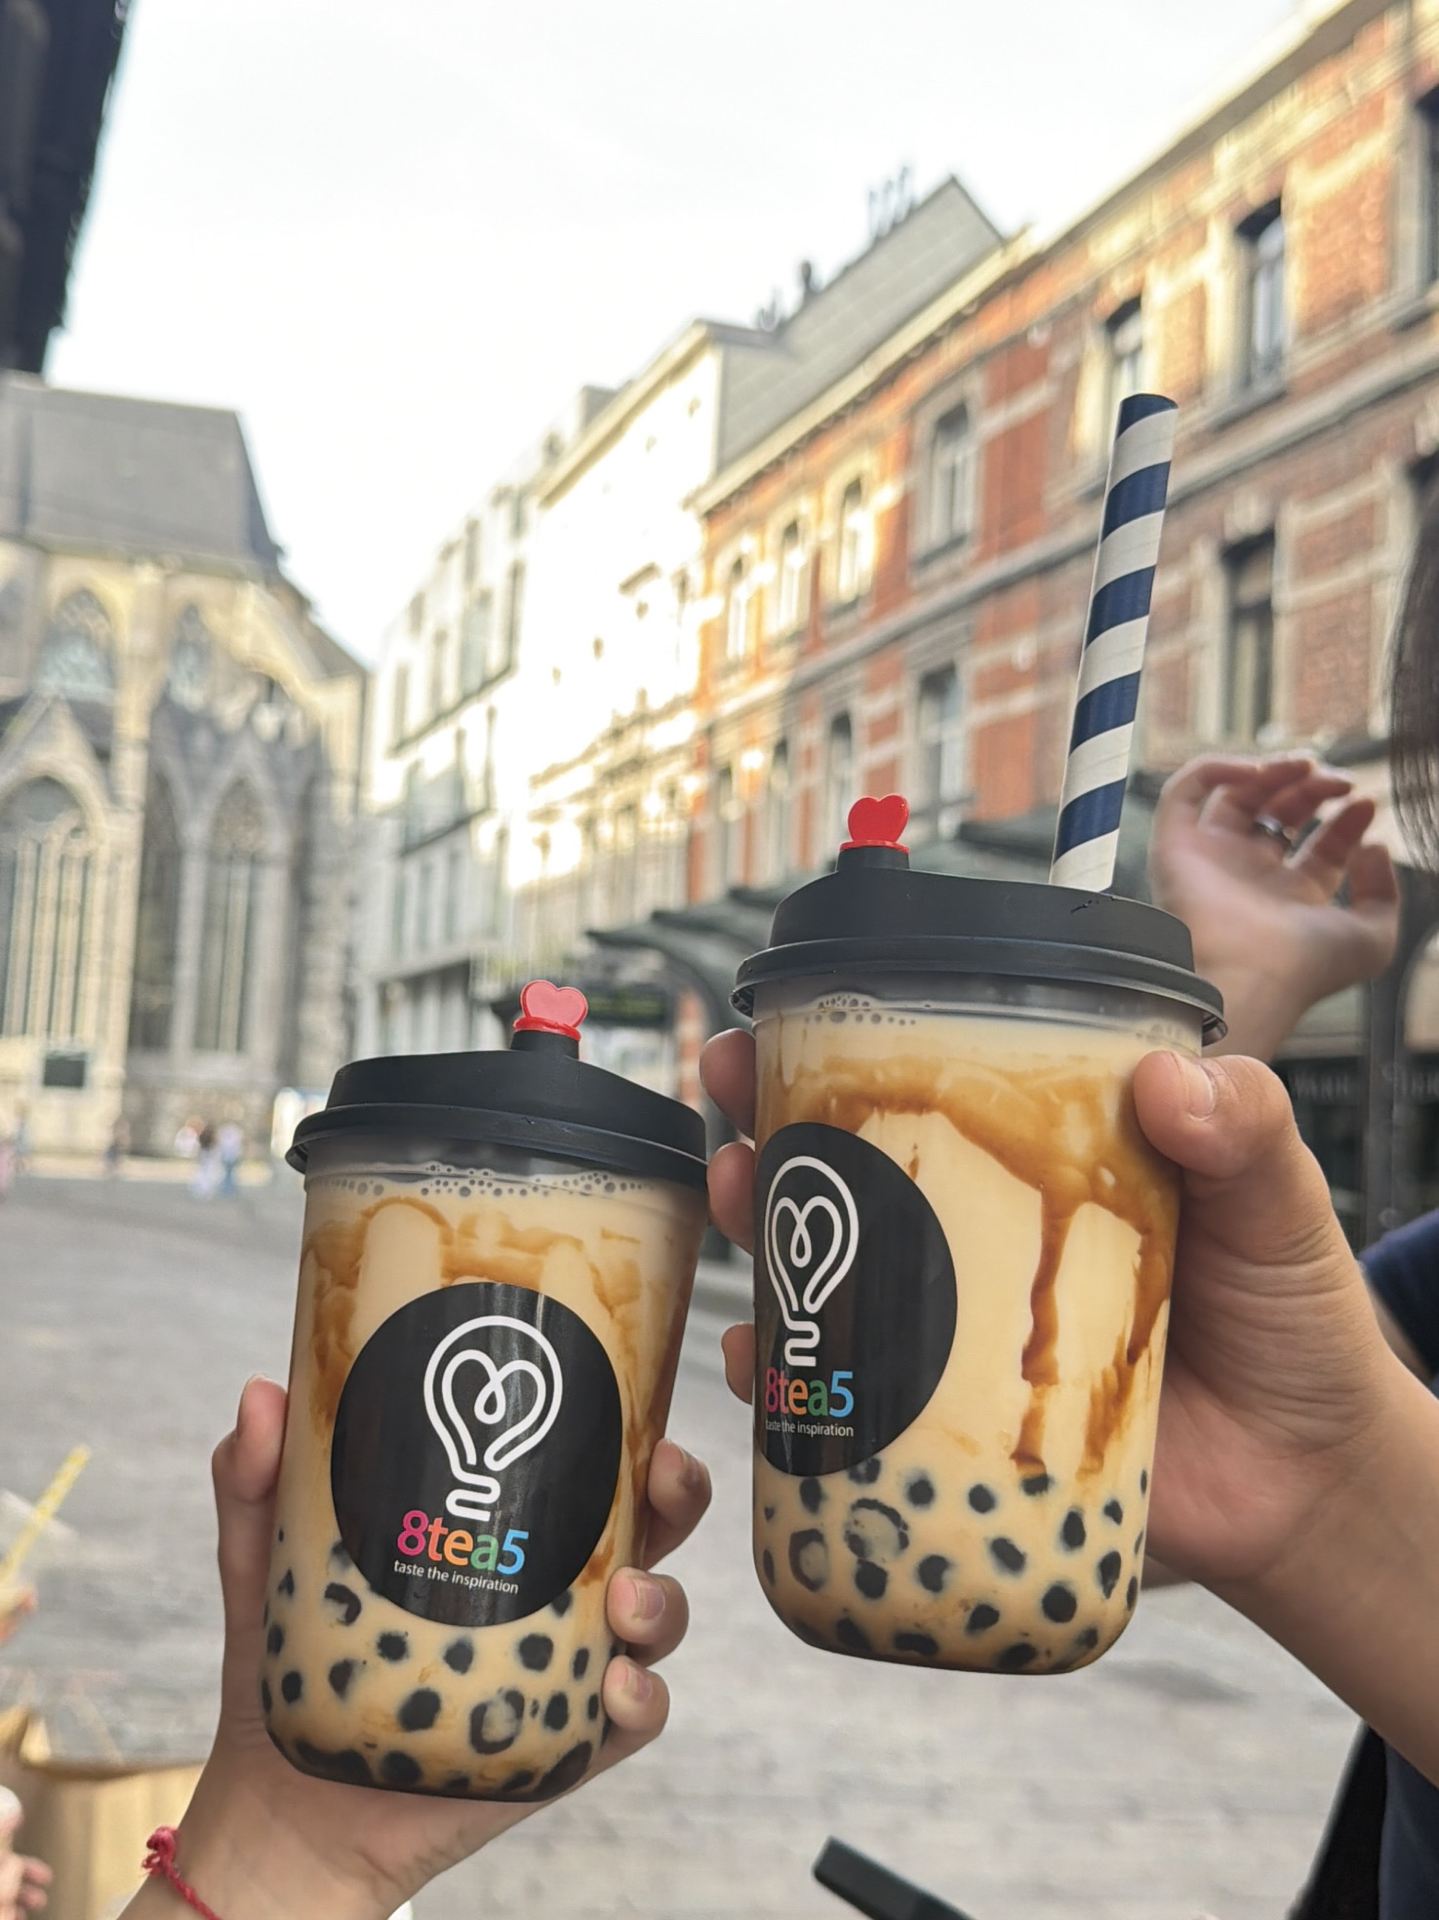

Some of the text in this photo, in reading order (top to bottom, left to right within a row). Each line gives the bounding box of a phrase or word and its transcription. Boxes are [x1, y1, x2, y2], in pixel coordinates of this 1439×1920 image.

[765, 1367, 854, 1418] 8tea5
[765, 1418, 854, 1438] taste the inspiration
[397, 1510, 529, 1575] 8tea5
[393, 1560, 519, 1594] taste the inspiration
